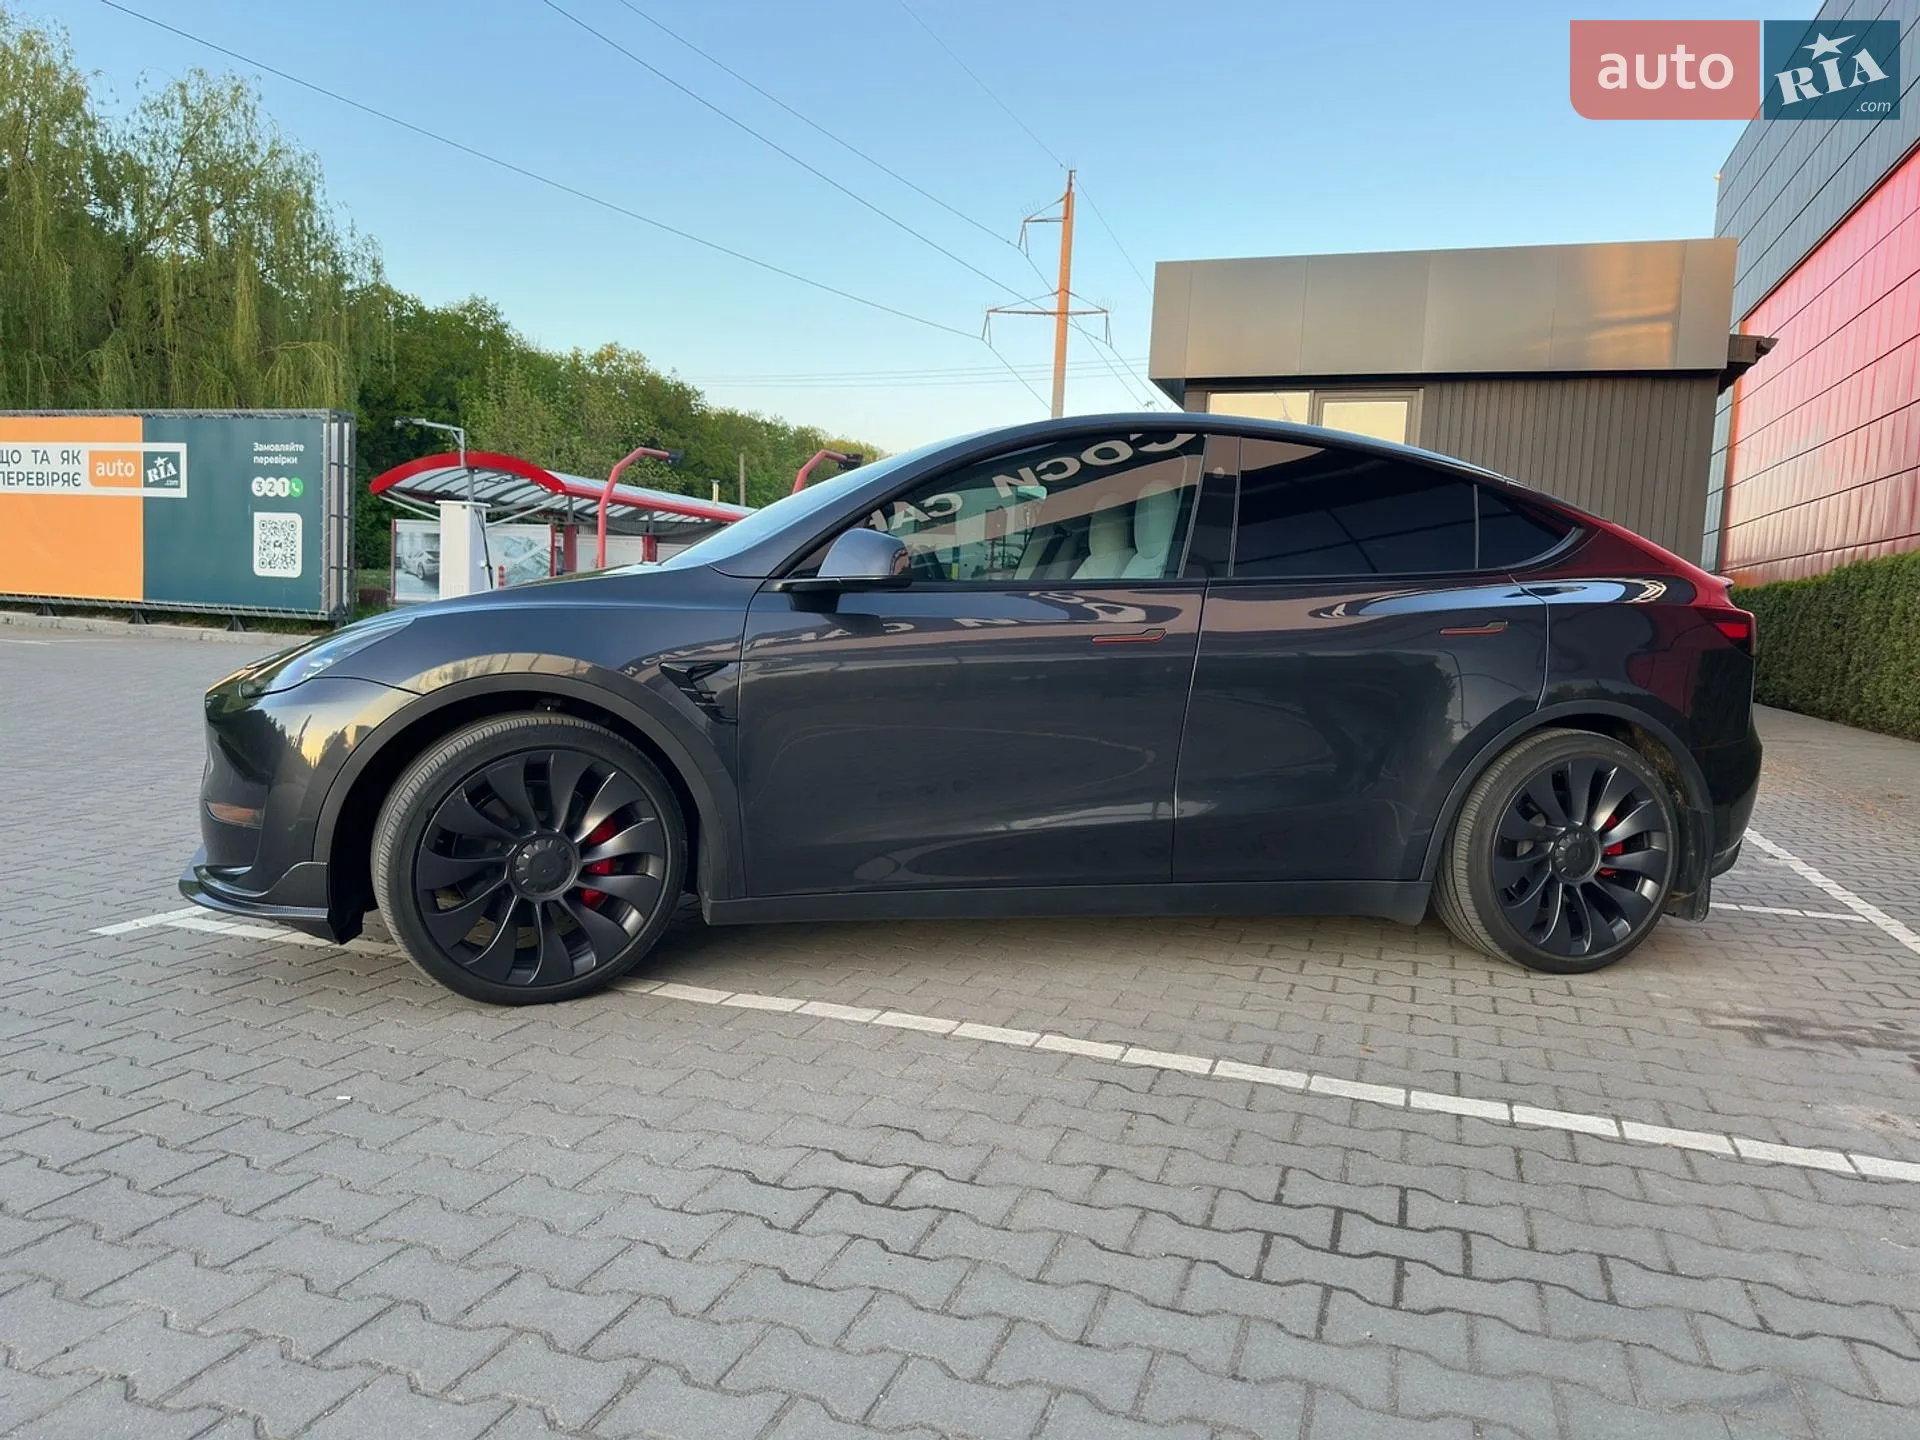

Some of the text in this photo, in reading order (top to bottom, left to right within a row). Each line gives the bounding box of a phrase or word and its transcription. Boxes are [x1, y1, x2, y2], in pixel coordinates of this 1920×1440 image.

[253, 442, 304, 452] Замовляйте
[31, 449, 51, 465] ТА
[60, 449, 81, 465] ЯК
[253, 454, 298, 466] перевірки
[95, 458, 177, 483] auto RIA
